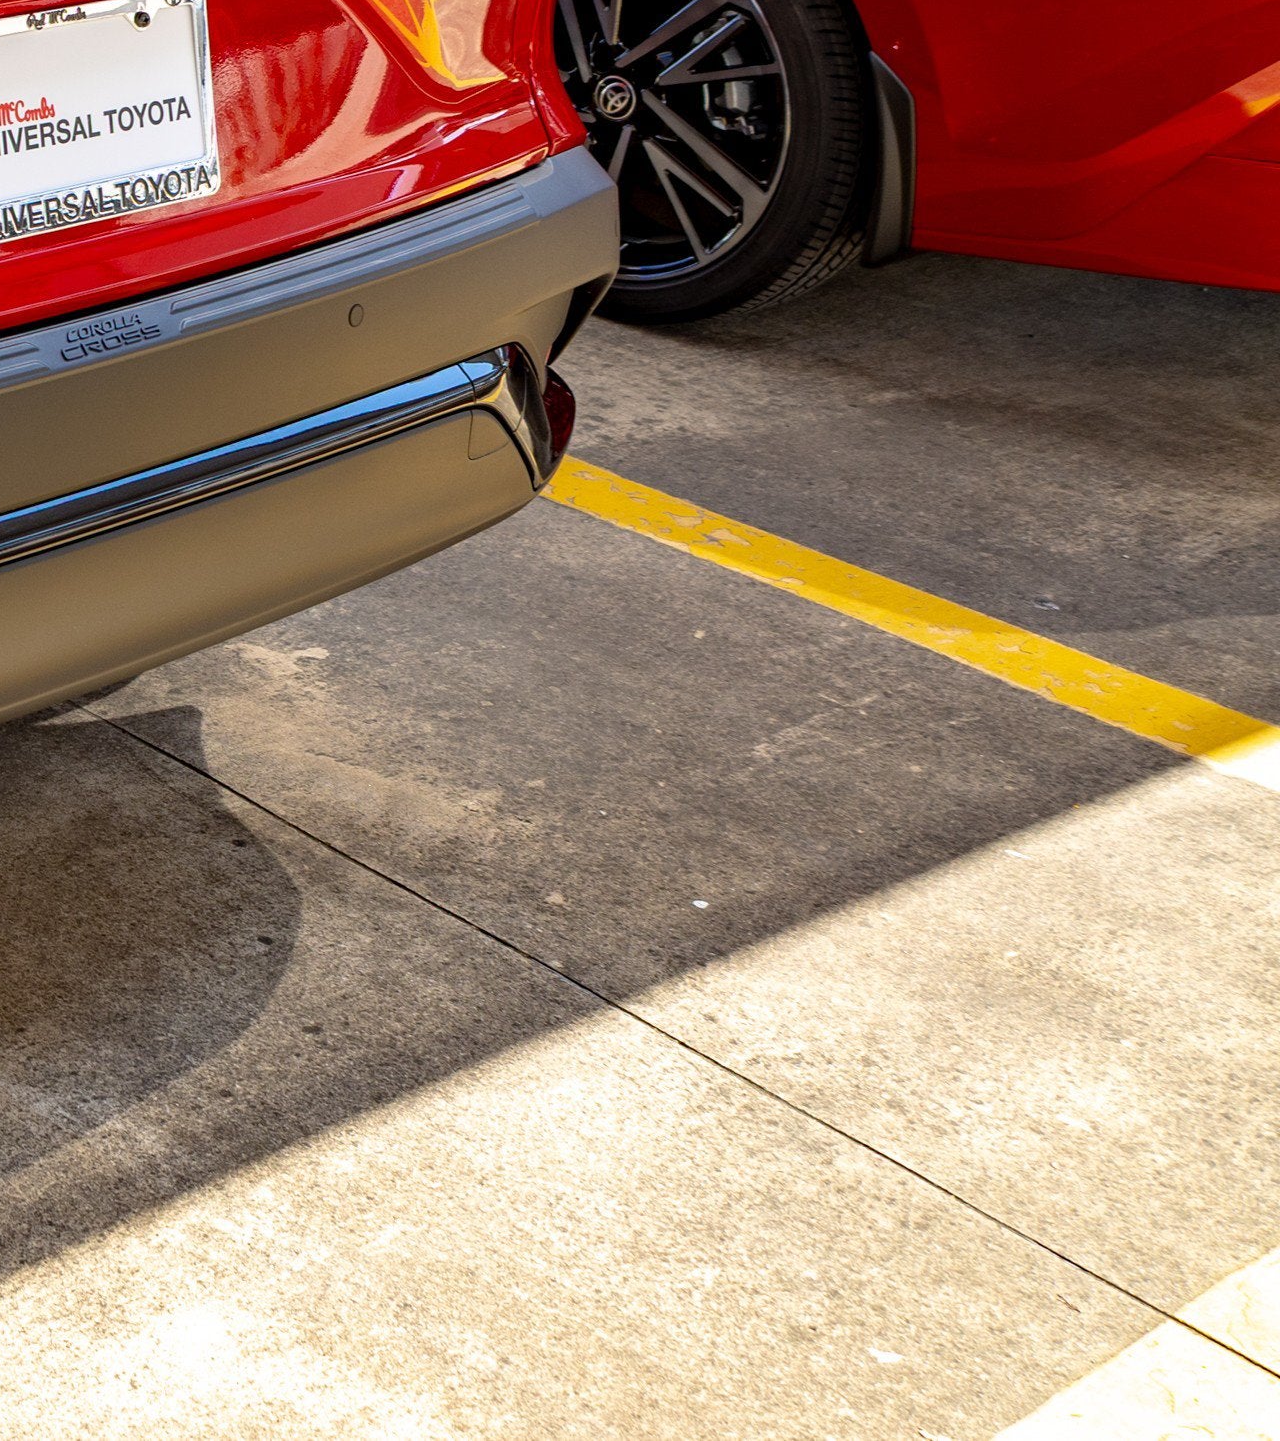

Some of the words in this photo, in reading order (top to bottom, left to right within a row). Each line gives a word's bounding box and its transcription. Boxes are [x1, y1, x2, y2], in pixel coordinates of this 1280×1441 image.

[26, 13, 46, 30] Red
[103, 96, 191, 135] TOYOTA
[114, 165, 212, 208] TOYOTA
[60, 324, 162, 361] CROSS
[66, 313, 142, 343] COROLLA
